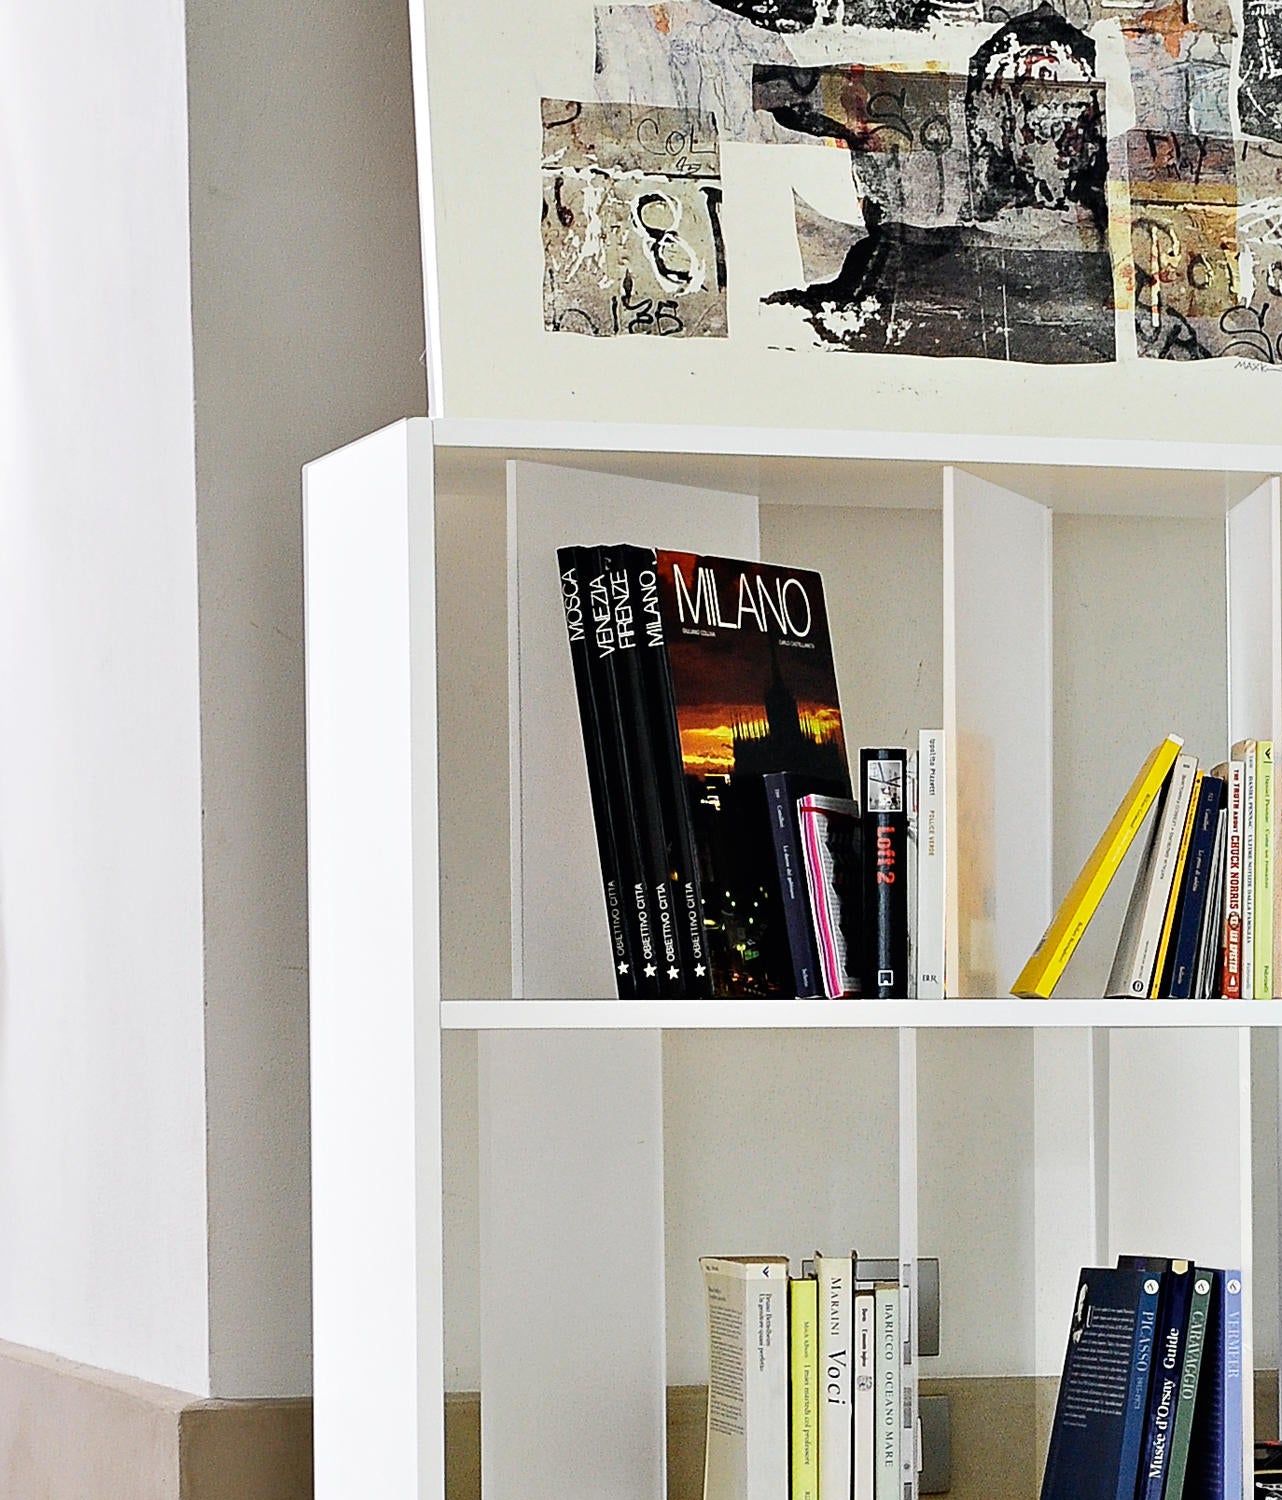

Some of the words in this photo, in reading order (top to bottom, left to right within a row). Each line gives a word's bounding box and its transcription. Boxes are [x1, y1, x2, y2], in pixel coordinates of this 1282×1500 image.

[560, 567, 584, 640] MOSCA
[588, 574, 615, 657] VENEZIA
[610, 568, 635, 648] FIRENZE
[638, 569, 663, 646] MILANO
[673, 563, 812, 638] MILANO
[1232, 783, 1240, 808] TRUTH
[876, 826, 894, 865] Loft
[1229, 835, 1240, 870] CHUCK
[876, 871, 894, 884] 2
[1229, 871, 1239, 909] NORRIS
[610, 908, 625, 956] OBIETTIVO
[638, 911, 652, 959] OBIETTIVO
[661, 911, 675, 961] OBIETTIVO
[688, 910, 702, 958] OBIETTIVO
[830, 1277, 842, 1335] MARAINI
[884, 1303, 894, 1360] BARICCO
[1134, 1310, 1155, 1372] PICASSO
[1161, 1327, 1181, 1369] Guide
[1179, 1309, 1206, 1400] CARAVAGGIO
[1227, 1311, 1240, 1378] VERMEER
[826, 1350, 846, 1404] Voci
[884, 1371, 894, 1426] OCEANO
[1154, 1377, 1176, 1430] d'Orsay
[884, 1431, 893, 1467] MARE
[1147, 1432, 1169, 1479] Musée
